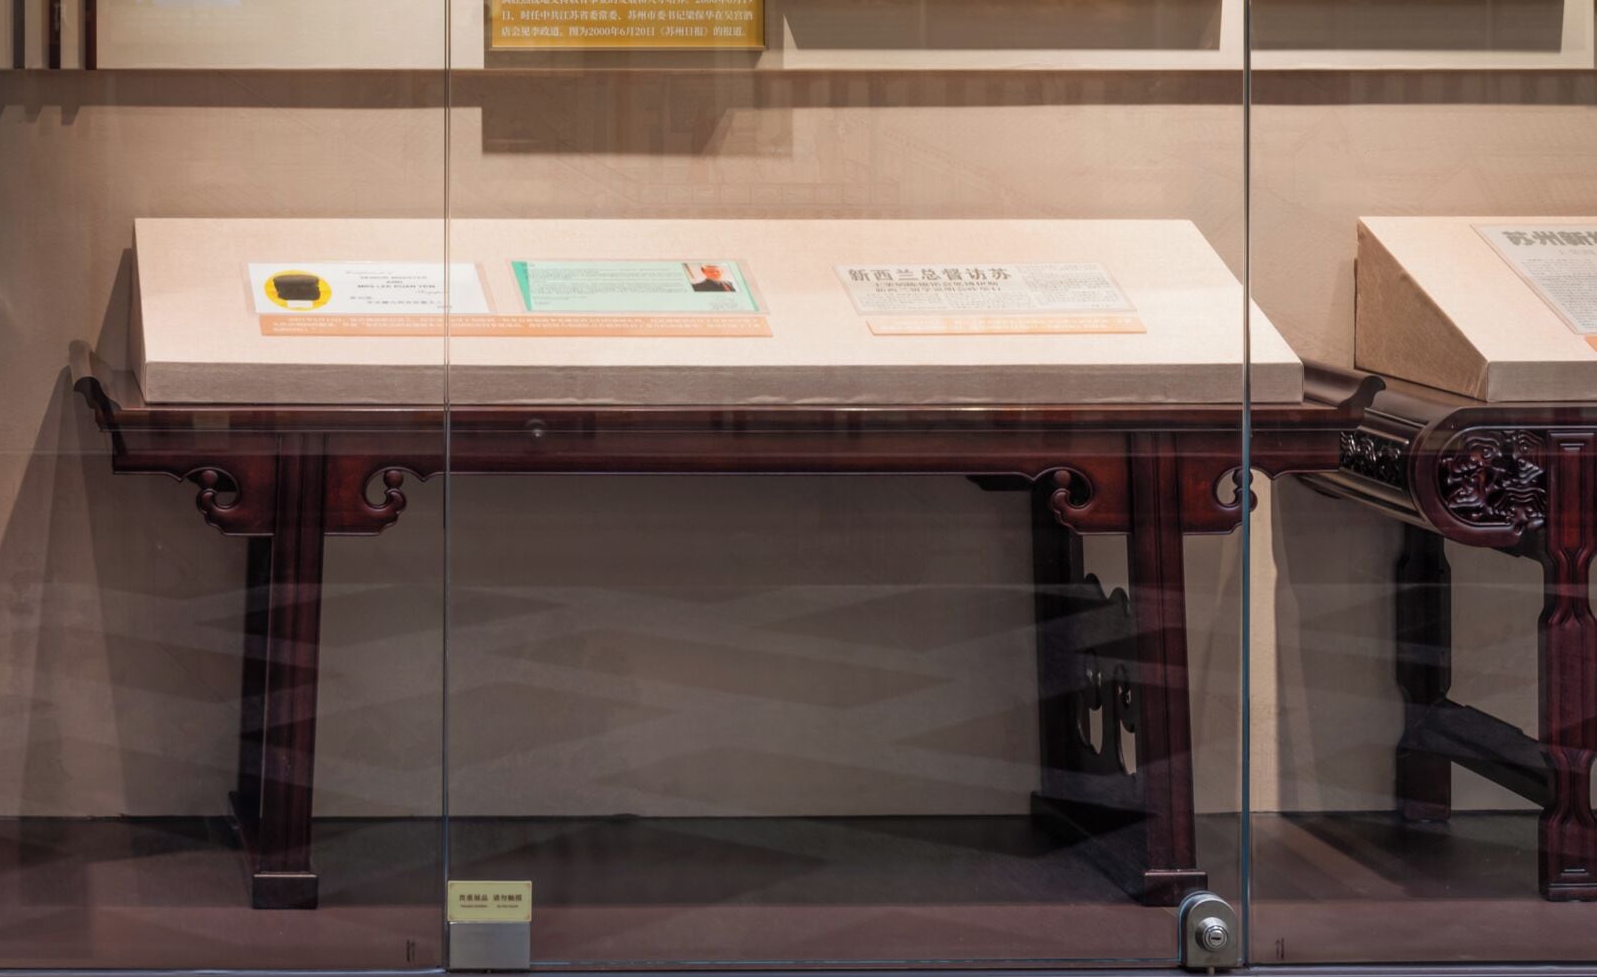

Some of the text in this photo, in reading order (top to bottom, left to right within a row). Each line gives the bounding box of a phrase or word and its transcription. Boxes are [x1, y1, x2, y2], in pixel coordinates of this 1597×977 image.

[849, 268, 1012, 281] 新西兰总督访苏
